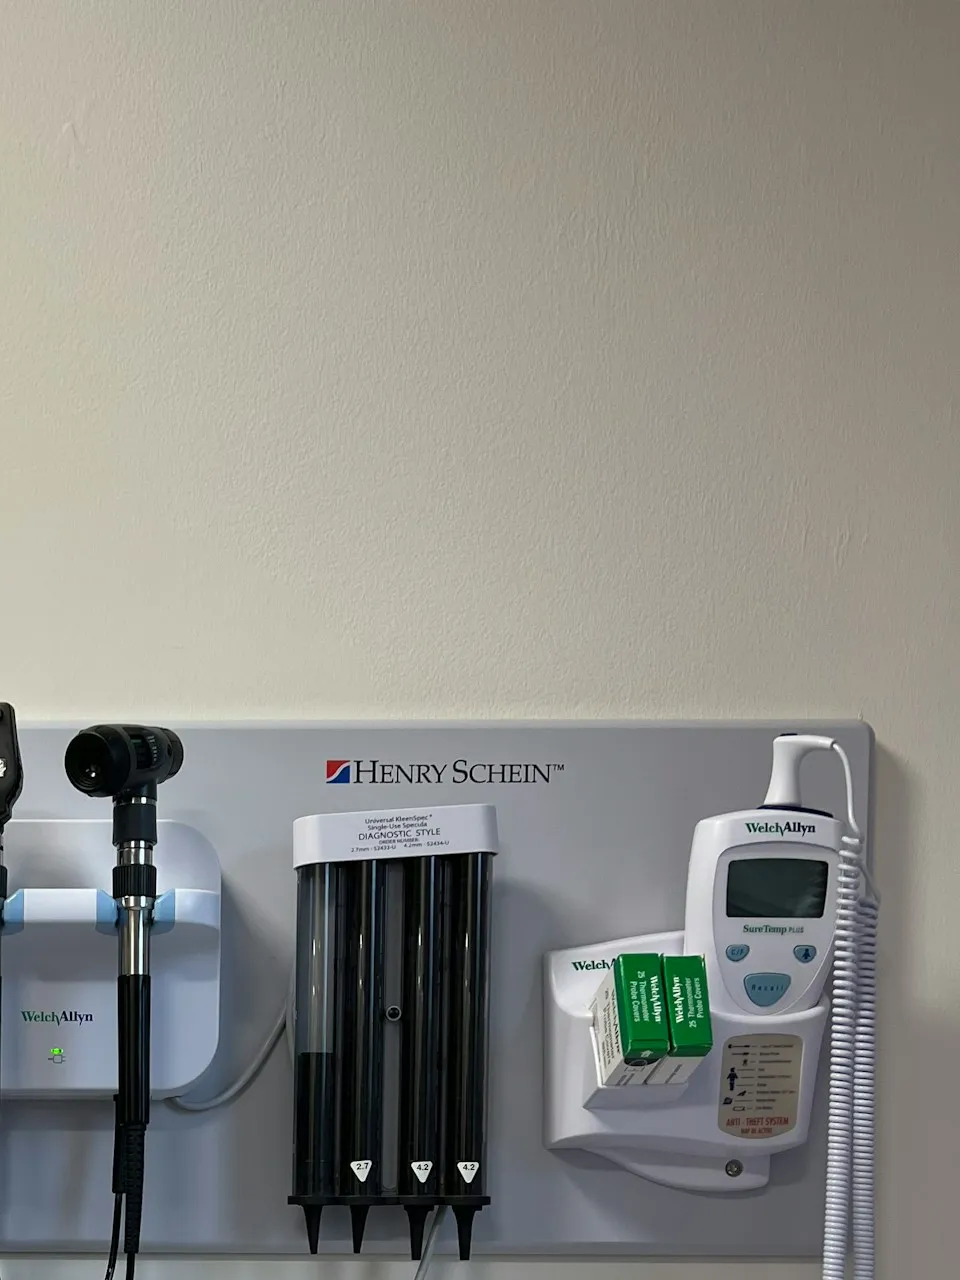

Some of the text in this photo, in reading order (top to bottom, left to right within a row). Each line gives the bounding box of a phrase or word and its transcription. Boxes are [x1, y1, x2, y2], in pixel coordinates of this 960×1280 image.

[353, 760, 448, 784] HENRY
[365, 817, 394, 825] Universal
[368, 821, 428, 831] Single-Use Specula
[745, 821, 816, 837] WelchAllyn
[358, 827, 440, 840] DIAGNOSTIC STYLE
[743, 924, 804, 936] SureTemp PLUS
[630, 981, 640, 1022] Probe Covers
[639, 981, 650, 1022] Thermometer
[650, 975, 662, 1022] WelchAllyn
[672, 976, 684, 1024] WelchAllyn
[685, 977, 697, 1028] 25 Thermometer
[694, 977, 704, 1018] Probe Covers
[21, 1010, 93, 1026] WelchAllyn
[765, 1116, 788, 1126] SYSTEM
[356, 1162, 369, 1170] 2.7
[416, 1163, 429, 1171] 4.2
[462, 1163, 476, 1171] 4.2
